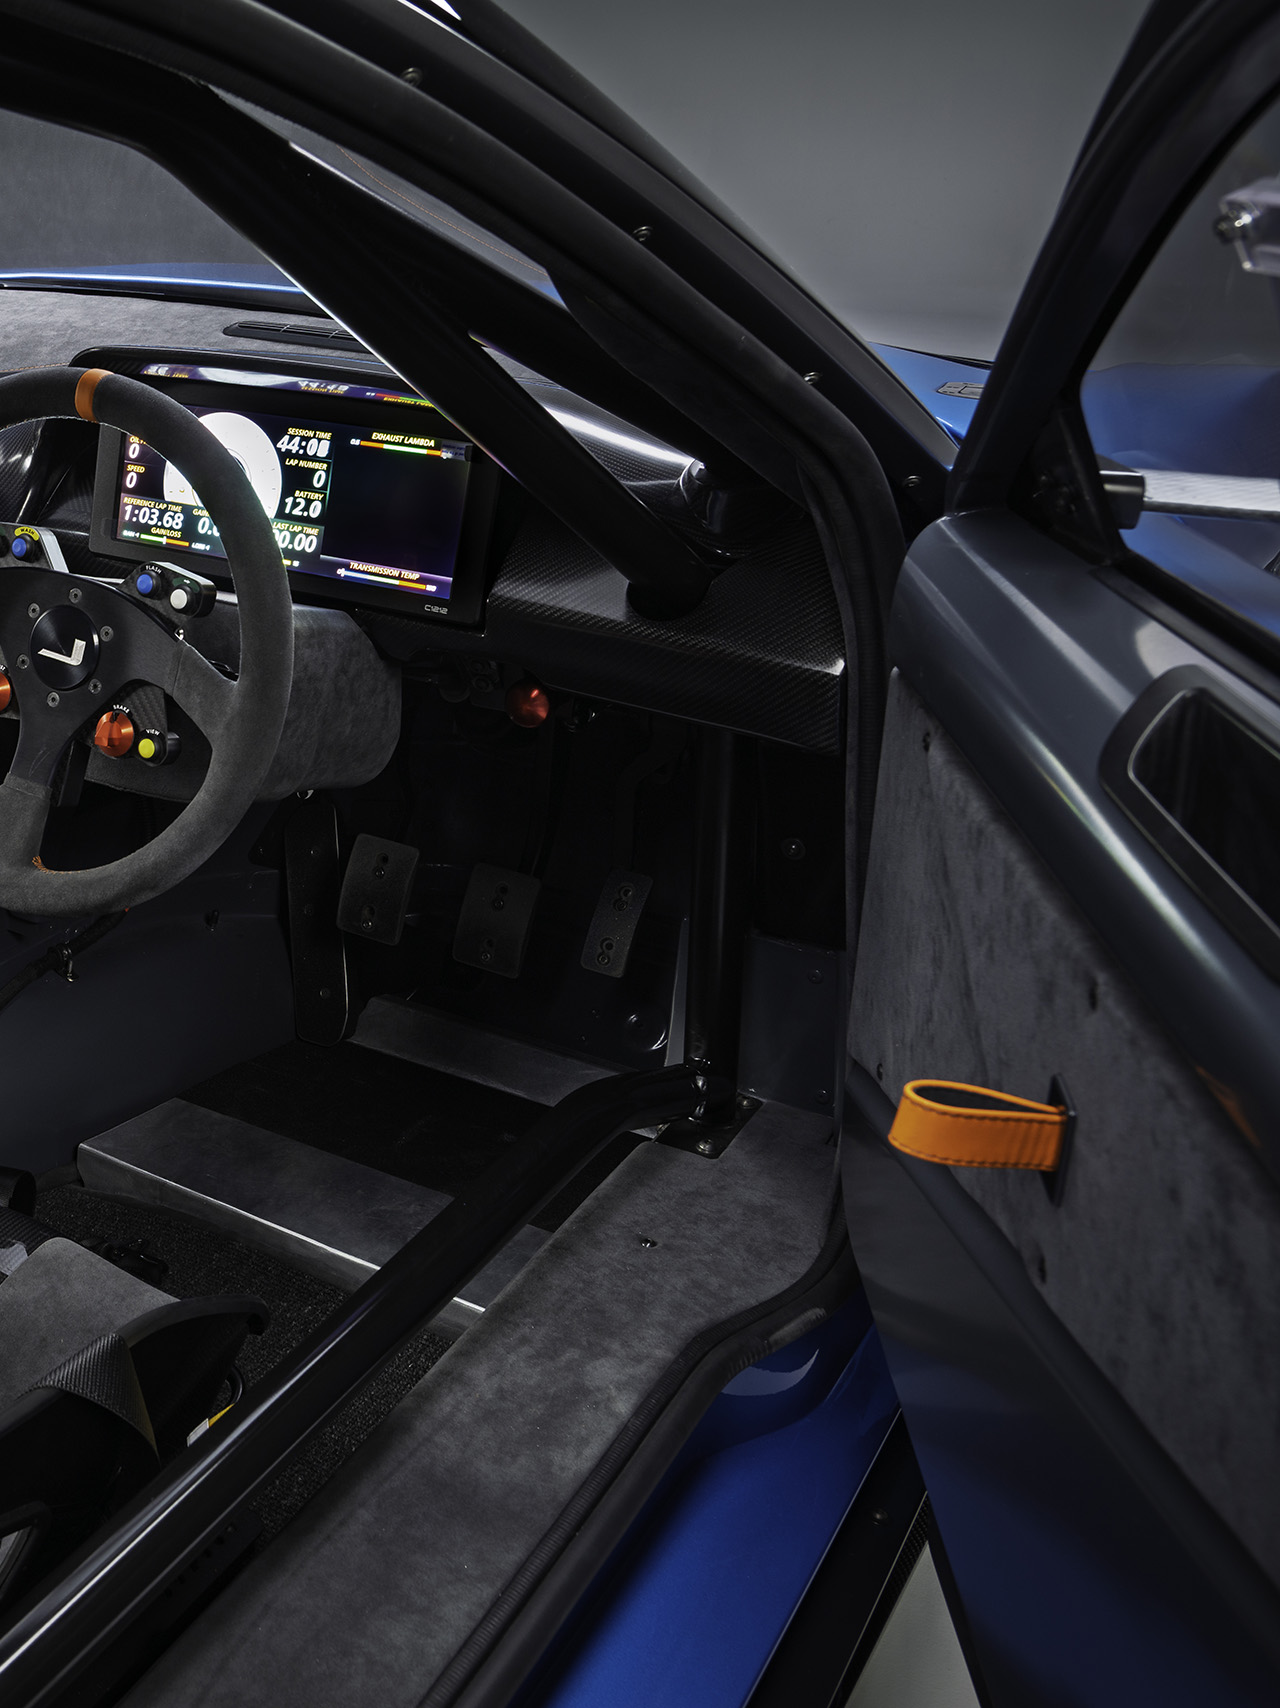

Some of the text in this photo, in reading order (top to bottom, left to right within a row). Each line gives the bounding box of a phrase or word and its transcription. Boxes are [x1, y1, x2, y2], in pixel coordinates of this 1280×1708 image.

[287, 427, 332, 440] SESSION TIME
[372, 432, 434, 447] EXHAUST LAMBDA
[129, 443, 139, 458] 0
[127, 464, 145, 473] SPEED
[285, 458, 327, 470] LAP NUMBER
[126, 472, 137, 488] 0
[313, 470, 326, 488] 0
[294, 490, 324, 501] BATTERY
[123, 497, 182, 512] REFERENCE LAP TIME
[284, 497, 322, 518] 12.0
[124, 504, 184, 530] 1:03.68
[273, 522, 319, 536] LAST LAP TIME
[146, 565, 161, 574] FLASH
[350, 562, 420, 581] TRANSMISSION TEMP
[146, 728, 160, 736] VIEW
